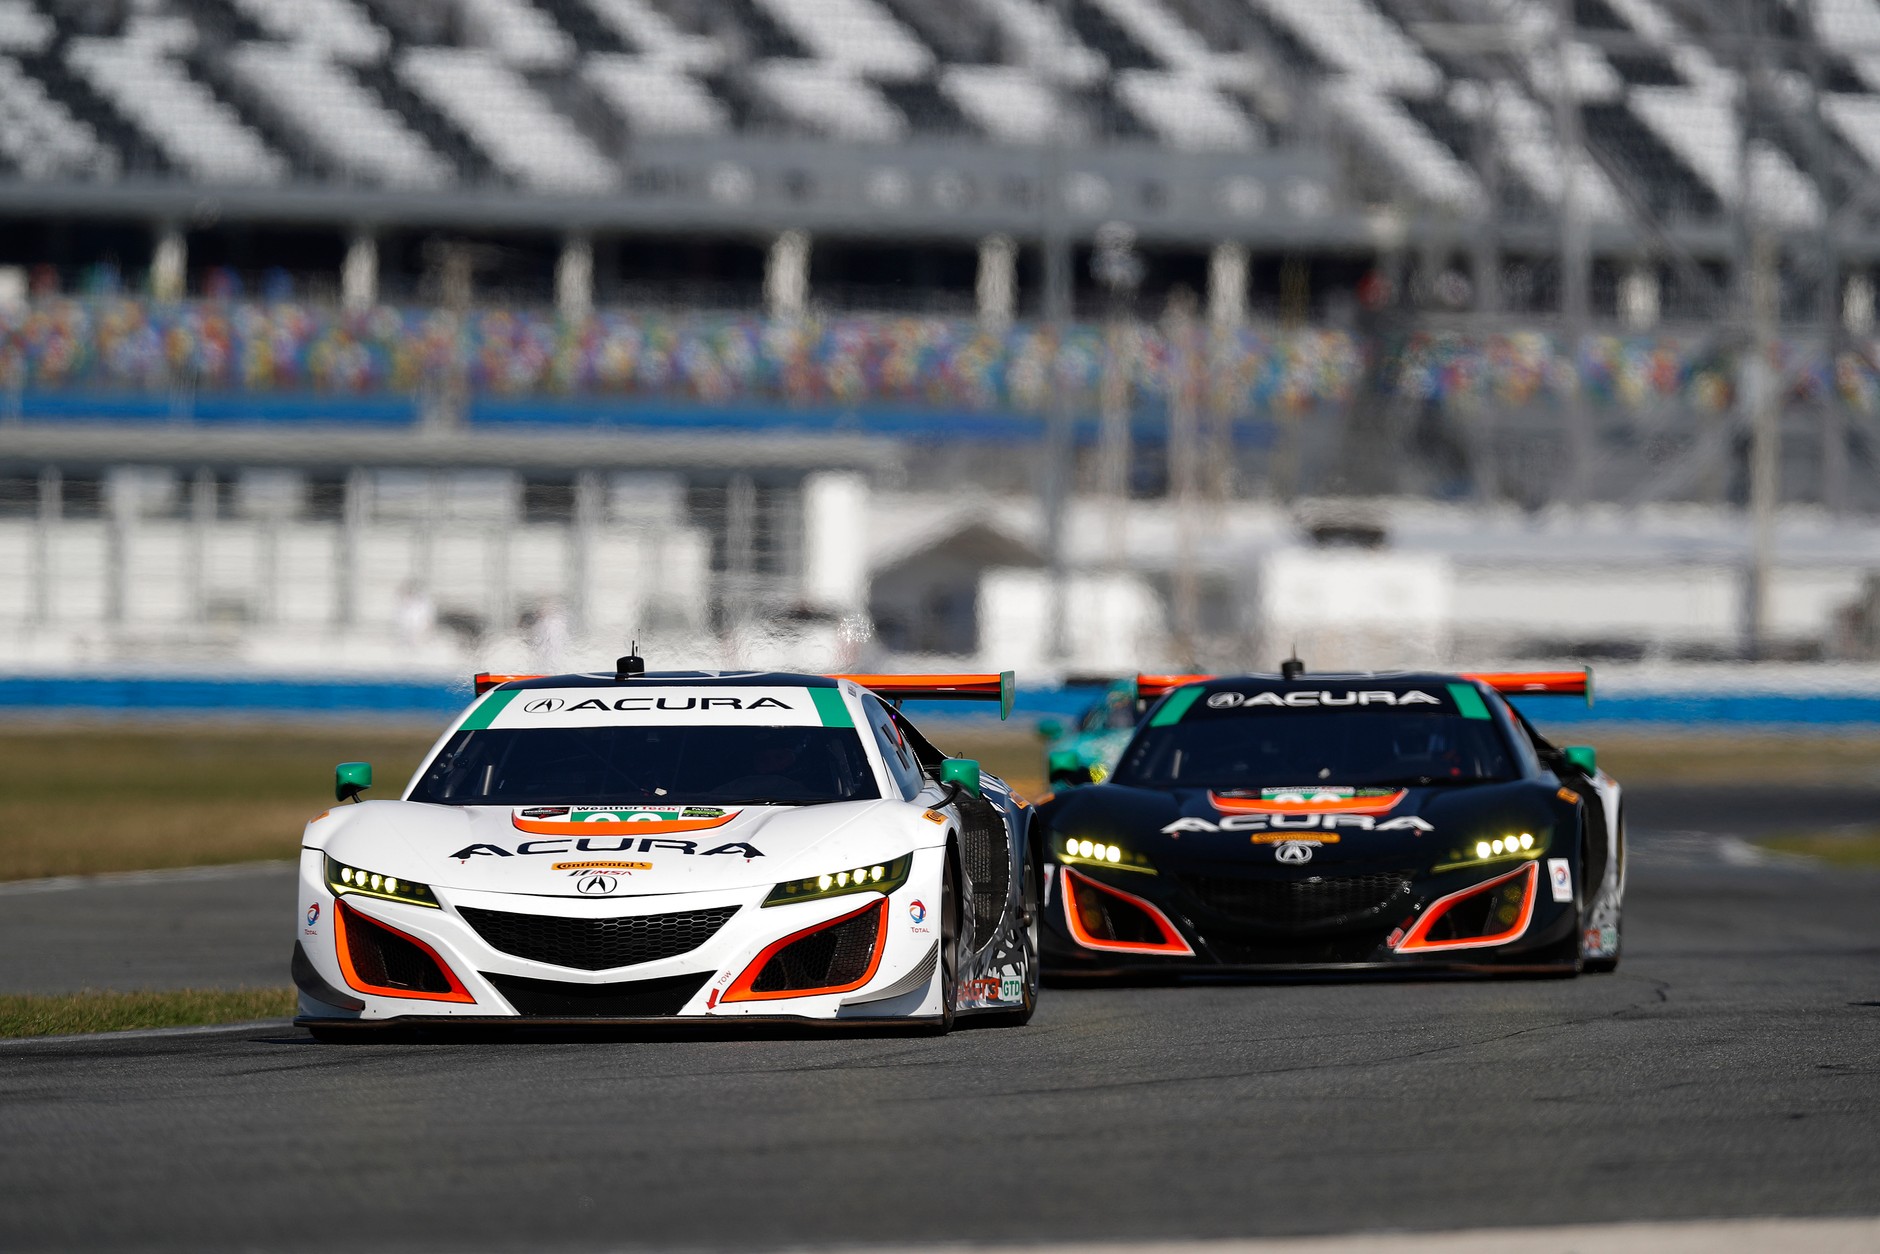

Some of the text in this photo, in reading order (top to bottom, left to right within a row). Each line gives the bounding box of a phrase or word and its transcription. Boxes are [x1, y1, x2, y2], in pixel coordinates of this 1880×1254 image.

[565, 697, 795, 711] ACURA
[1243, 690, 1441, 707] ACURA
[1161, 813, 1435, 832] ACURA
[449, 838, 766, 859] ACURA
[556, 861, 635, 869] Continental
[717, 970, 732, 986] TOW
[1003, 980, 1020, 997] GTD
